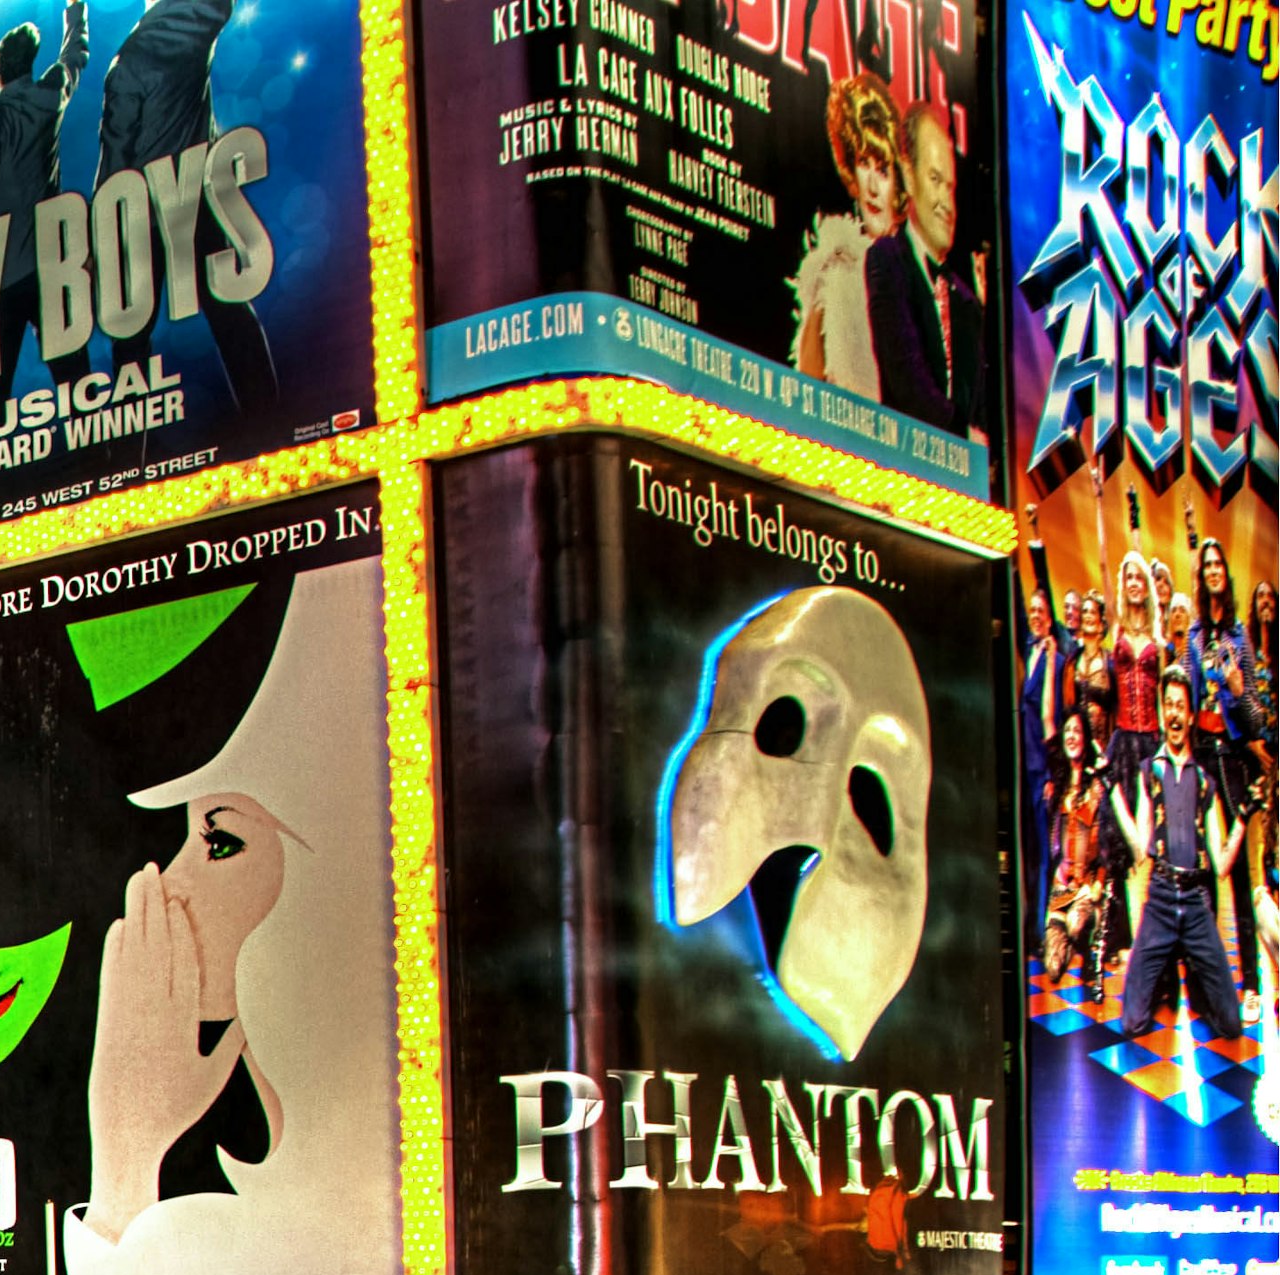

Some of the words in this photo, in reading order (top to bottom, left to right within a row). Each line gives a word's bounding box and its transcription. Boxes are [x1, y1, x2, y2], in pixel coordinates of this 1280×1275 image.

[493, 0, 580, 45] KELSEY
[589, 0, 656, 56] GRAMMER
[557, 43, 588, 87] LA
[597, 47, 638, 105] CAGE
[645, 70, 674, 122] AUX
[679, 86, 735, 150] FOLLES
[676, 33, 730, 94] DOUGLAS
[733, 62, 771, 114] HODGE
[499, 98, 554, 128] MUSIC
[576, 98, 622, 124] LYRICS
[499, 116, 564, 166] JERRY
[576, 115, 638, 167] HERMAN
[526, 168, 564, 185] BASED
[668, 149, 714, 200] HARVEY
[716, 172, 776, 229] FIERSTEIN
[35, 127, 276, 361] BOYS
[465, 302, 584, 359] LACAGE.COM
[636, 314, 688, 366] LONGACRE
[740, 359, 761, 396] 220
[65, 390, 185, 451] WINNER
[2, 496, 38, 519] 245
[42, 480, 93, 508] WEST
[145, 447, 219, 481] STREET
[627, 457, 741, 548] Tonight
[746, 491, 848, 585] belongs
[499, 1068, 995, 1202] PHANTOM
[927, 1231, 968, 1251] MAJESTIC
